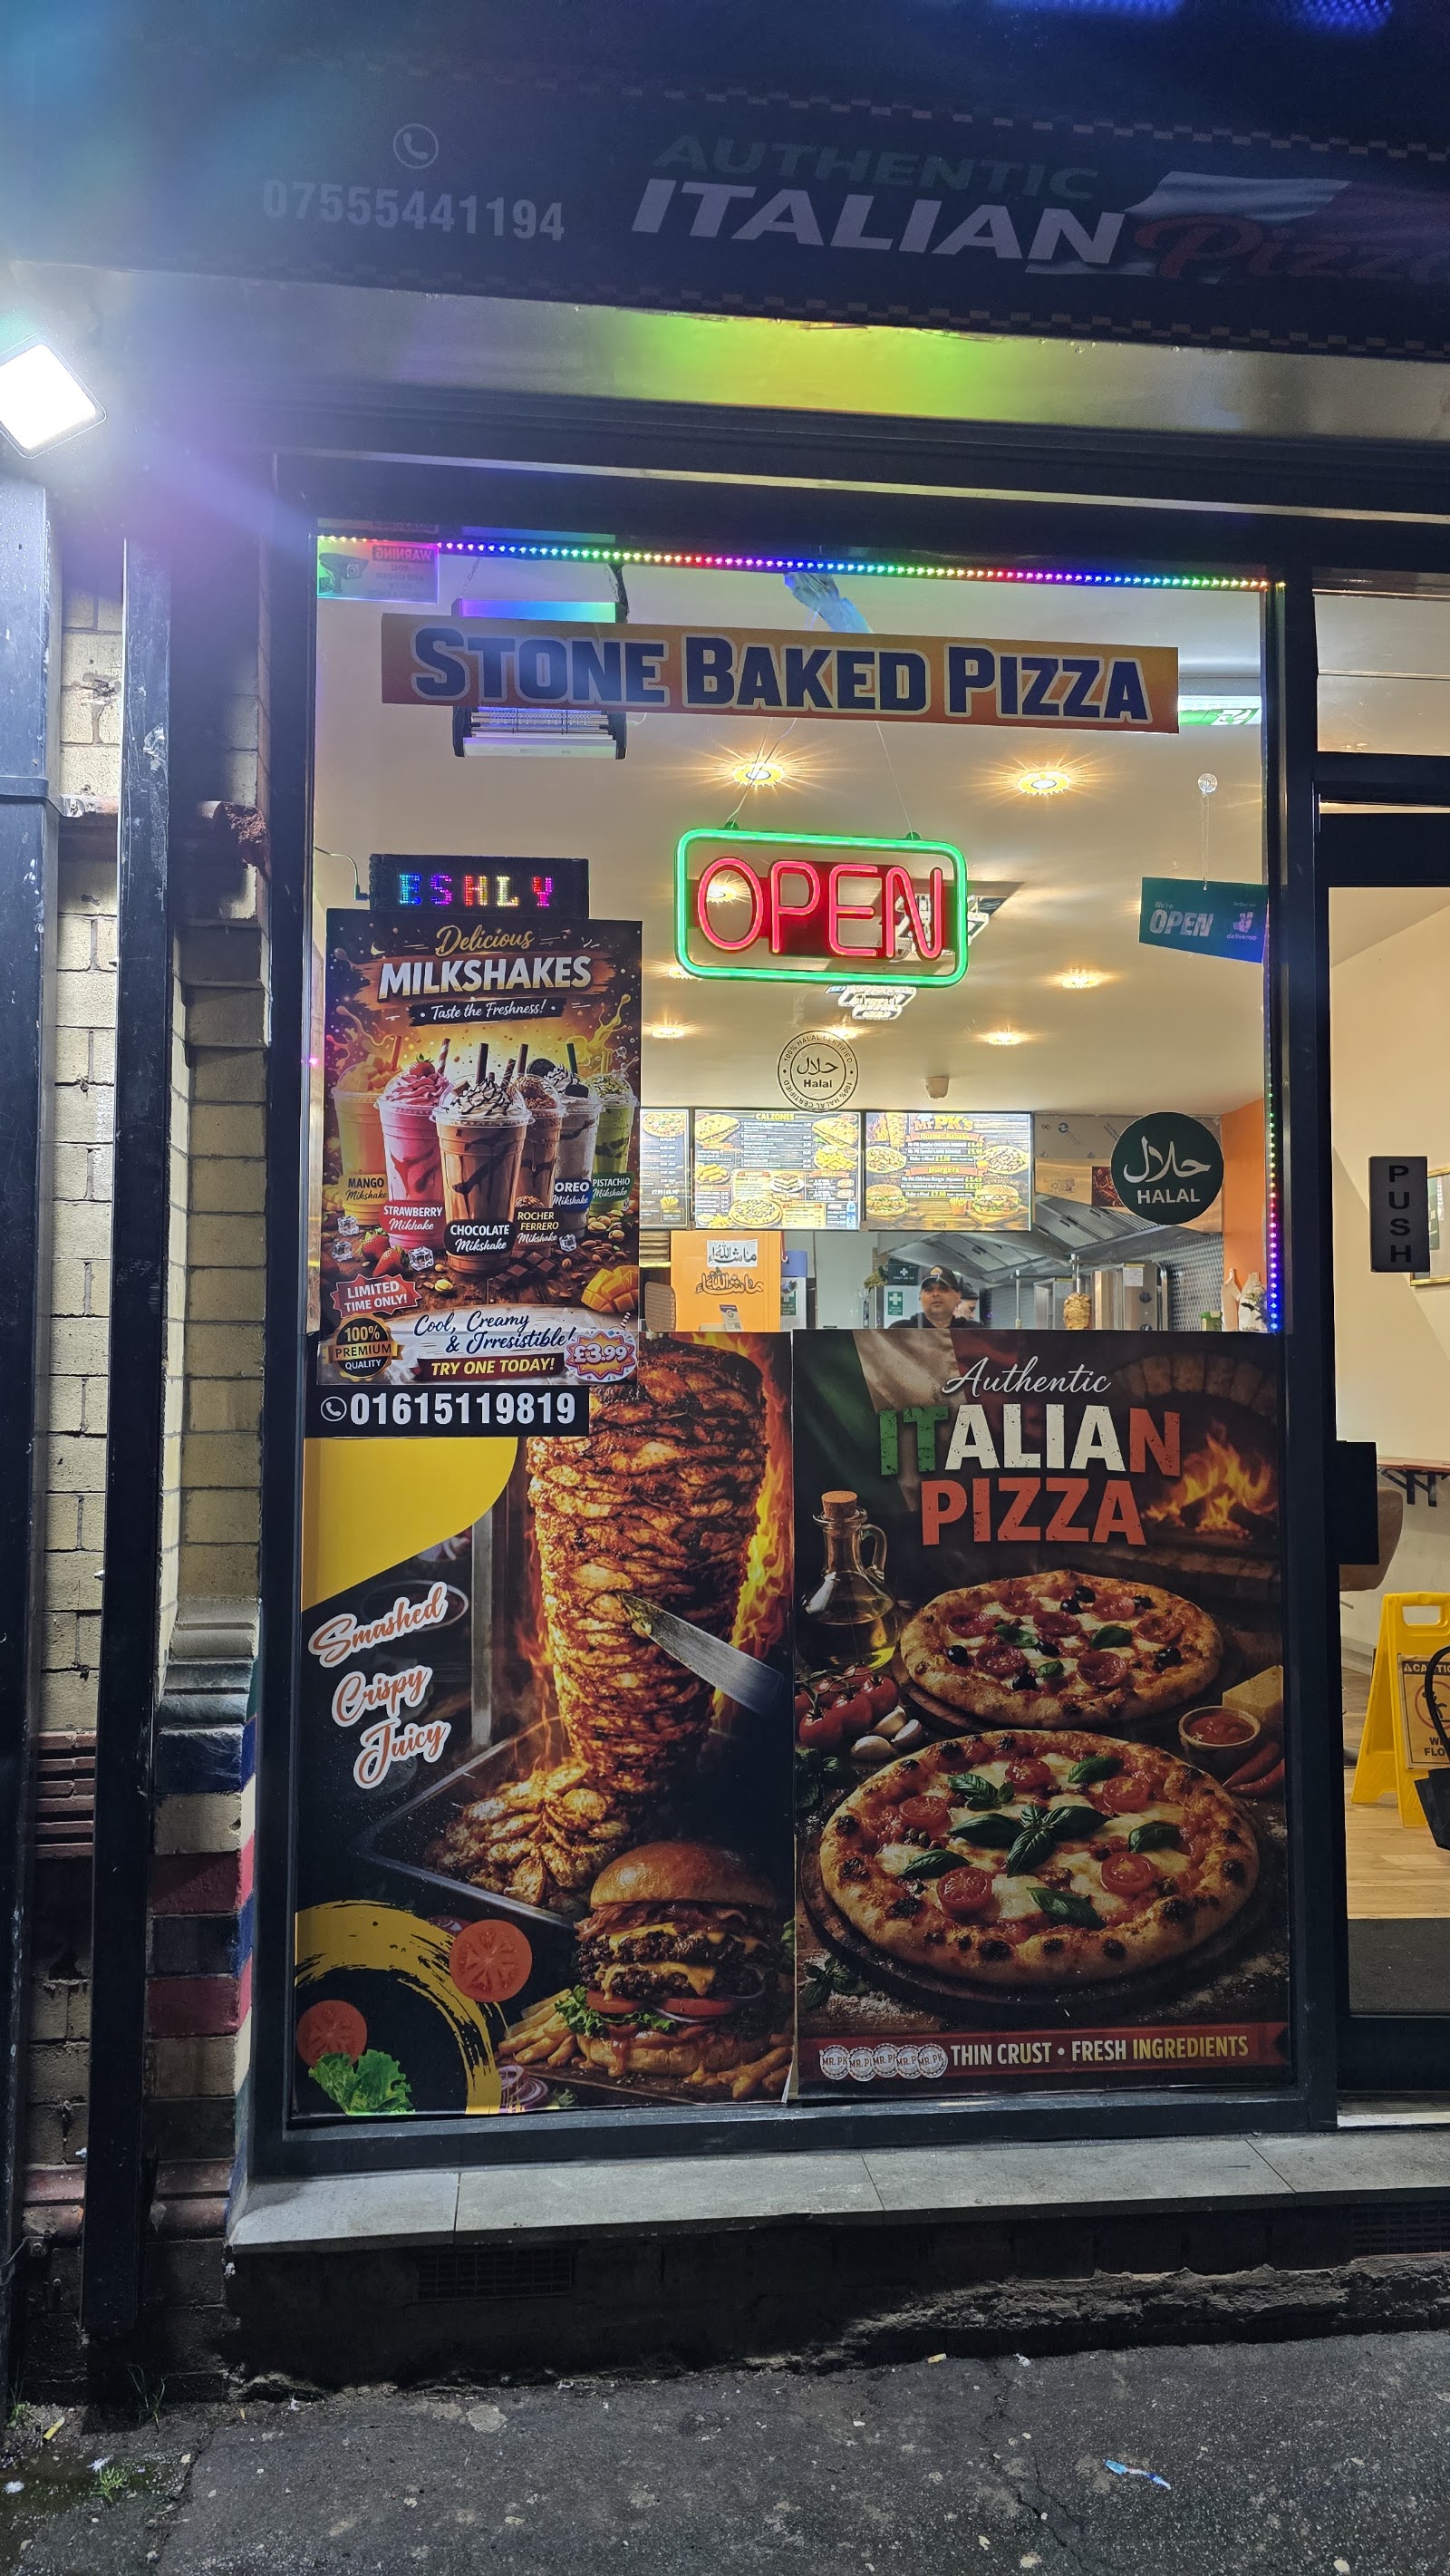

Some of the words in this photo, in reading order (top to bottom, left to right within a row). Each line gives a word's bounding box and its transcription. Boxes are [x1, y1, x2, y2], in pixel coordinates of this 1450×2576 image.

[653, 133, 1099, 200] AUTHENTIC
[263, 180, 565, 242] 07555441194
[632, 179, 1126, 265] ITALIAN
[412, 626, 669, 708] STONE
[682, 634, 930, 714] BAKED
[944, 643, 1152, 722] PIZZA
[698, 857, 942, 961] OPEN
[1149, 909, 1214, 937] OPEN
[435, 925, 536, 957] Delicious
[1226, 933, 1258, 941] deliveroo
[378, 955, 592, 1000] MILKSHAKES
[430, 1004, 461, 1021] Taste
[463, 1002, 482, 1018] the
[486, 999, 547, 1018] Freshness!
[784, 1045, 798, 1061] 100%
[796, 1034, 821, 1046] HALAL
[823, 1035, 853, 1064] CERTIFIED
[797, 1057, 839, 1076] حلال
[783, 1080, 814, 1109] CERTIFIED
[803, 1079, 833, 1089] Halal
[839, 1081, 853, 1099] 100%
[816, 1097, 840, 1109] HALAL
[1123, 1135, 1212, 1184] حلال
[347, 1177, 384, 1188] MANGO
[554, 1181, 590, 1193] OREO
[592, 1177, 631, 1187] PISTACHIO
[1136, 1188, 1201, 1205] HALAL
[383, 1205, 443, 1217] STRAWBERRY
[517, 1211, 555, 1221] ROCHER
[1388, 1165, 1412, 1263] PUSH
[450, 1225, 510, 1236] CHOCOLATE
[520, 1221, 559, 1231] FERRERO
[346, 1281, 400, 1299] LIMITED
[343, 1299, 372, 1312] TIME
[373, 1293, 408, 1308] ONLY!
[344, 1325, 381, 1342] 100%
[413, 1312, 457, 1336] Cool,
[466, 1310, 531, 1334] Creamy
[335, 1343, 392, 1359] PREMIUM
[445, 1335, 460, 1353] &
[465, 1326, 577, 1354] Irresistible!
[344, 1360, 382, 1370] QUALITY
[573, 1343, 629, 1364] £3.99
[430, 1361, 462, 1376] TRY
[463, 1360, 495, 1375] ONE
[499, 1357, 556, 1374] TODAY!
[941, 1355, 1112, 1398] Authentic
[350, 1391, 576, 1426] 01615119819
[878, 1402, 1181, 1477] ITALIAN
[921, 1477, 1147, 1546] PIZZA
[310, 1583, 446, 1665] Smashed
[334, 1667, 430, 1724] Crispy
[356, 1719, 449, 1786] Juicy
[918, 2056, 933, 2067] MR.
[933, 2053, 944, 2064] PK
[951, 2044, 992, 2067] THIN
[997, 2042, 1052, 2066] CRUST
[1071, 2039, 1127, 2062] FRESH
[1132, 2035, 1249, 2059] INGREDIENTS
